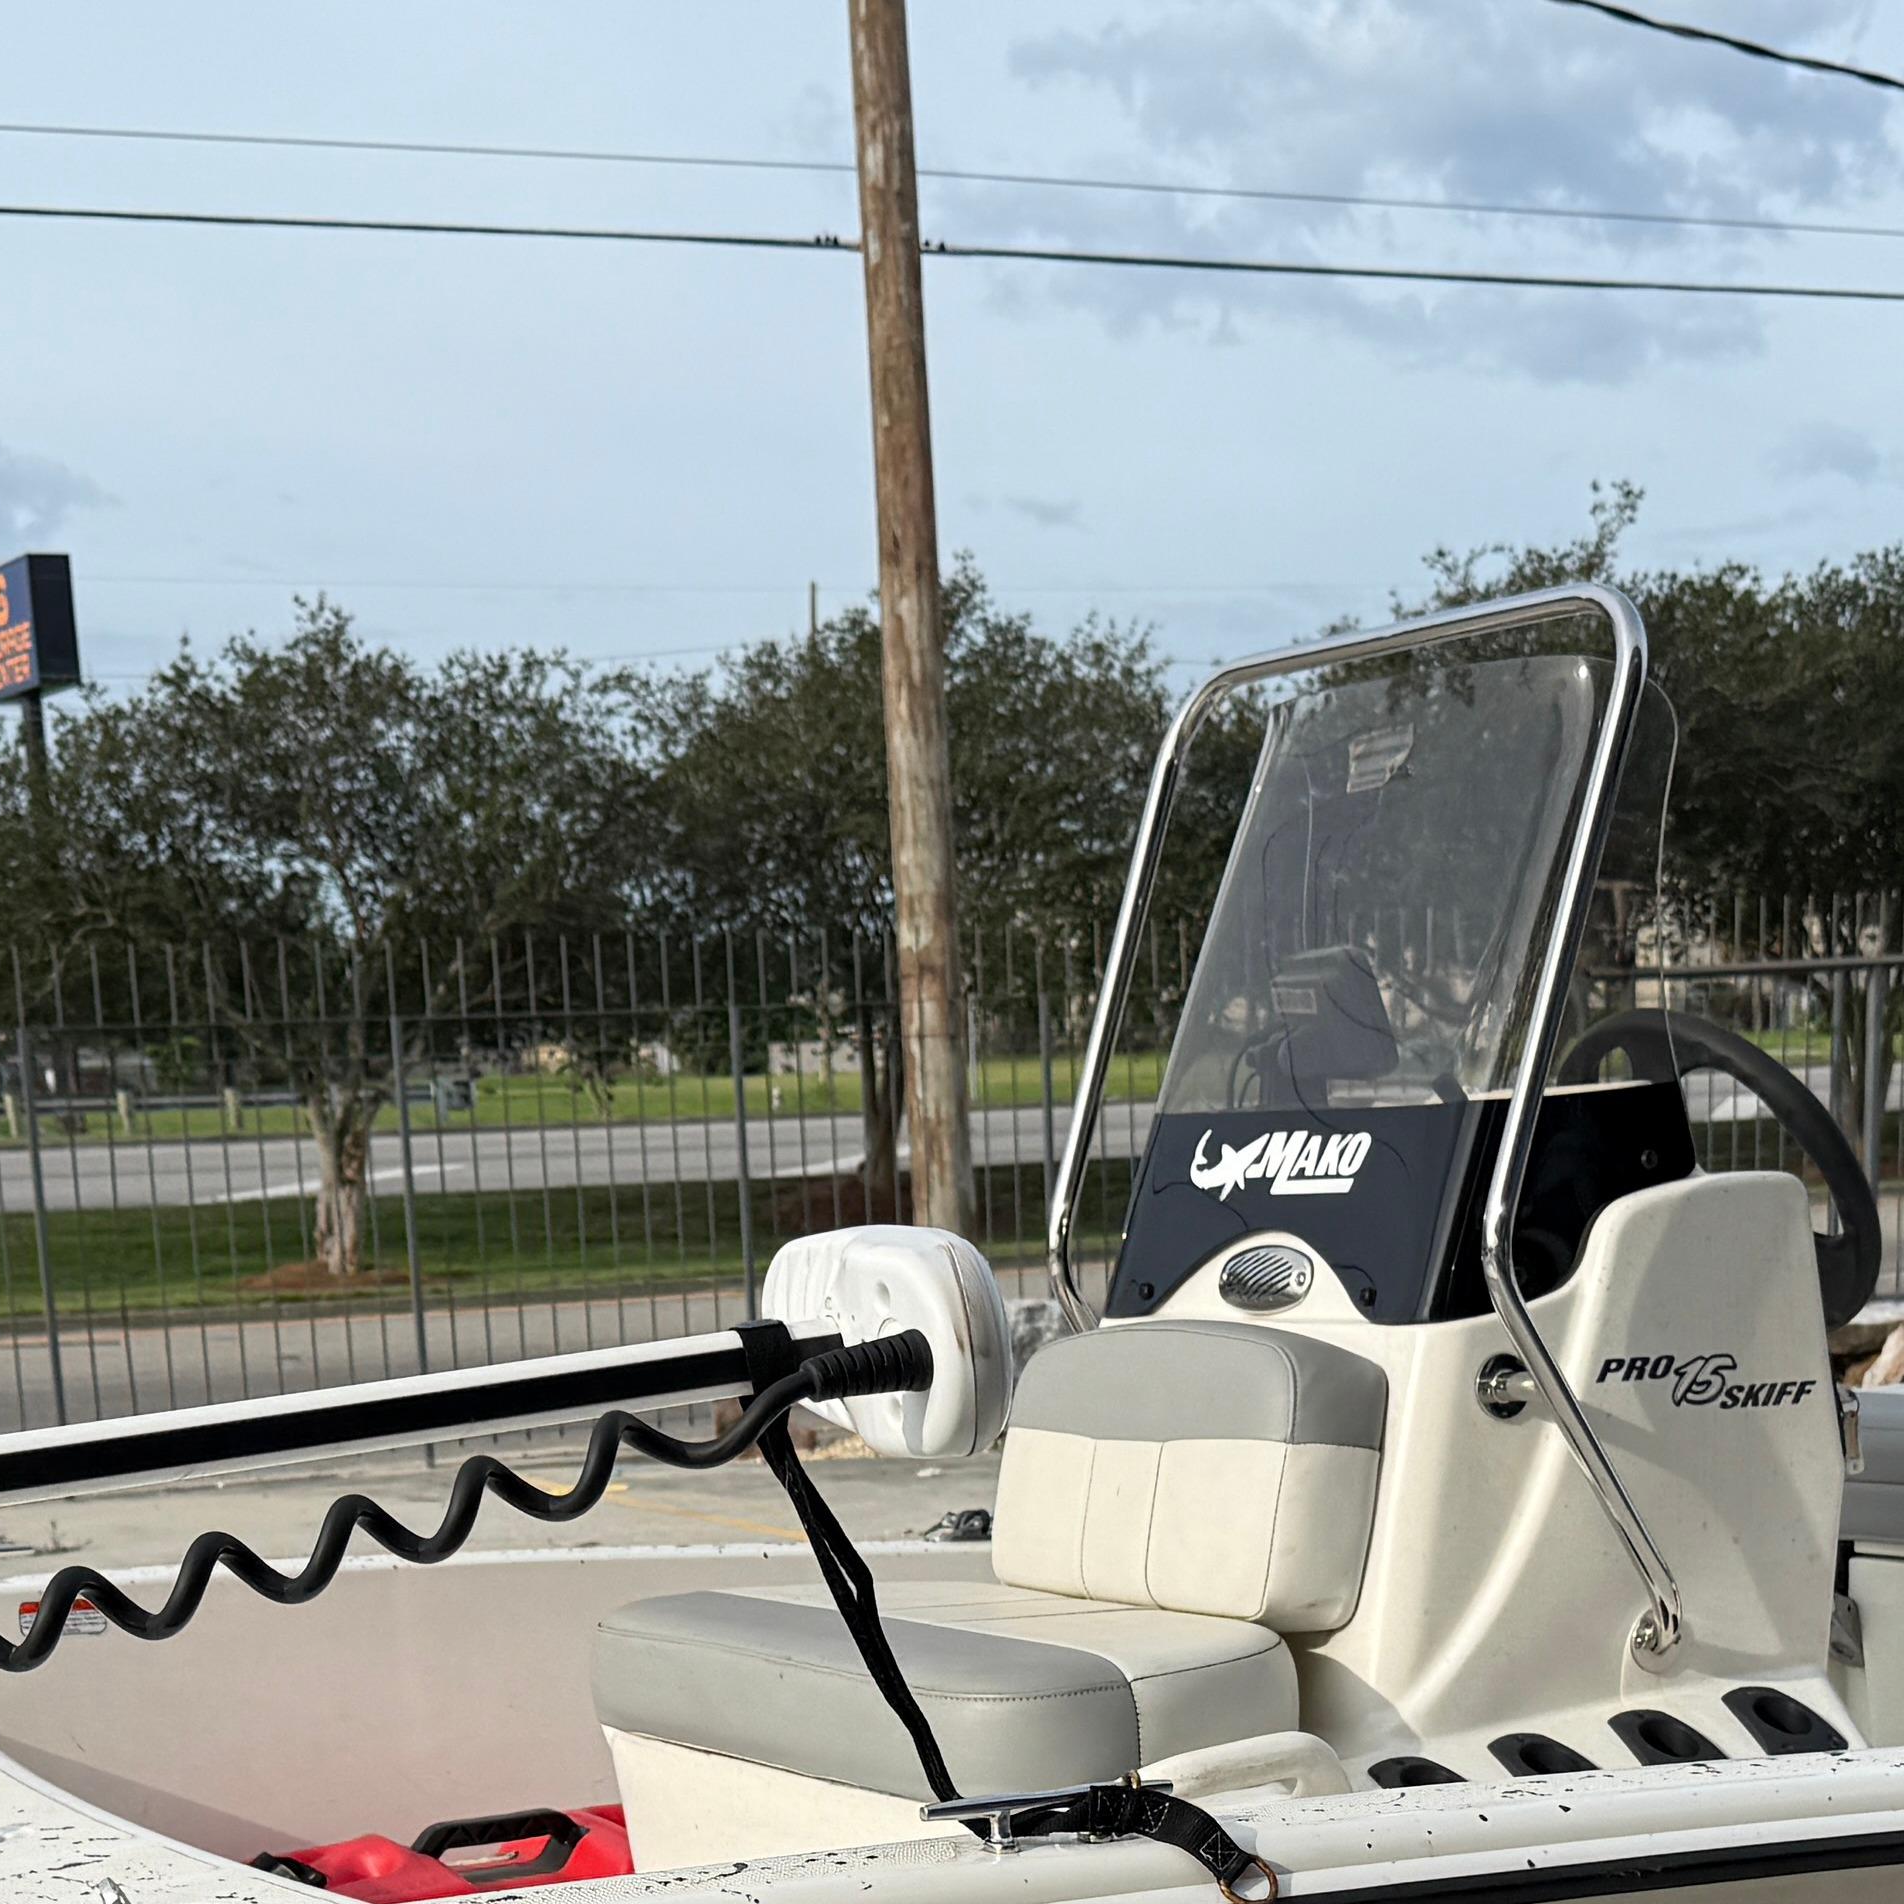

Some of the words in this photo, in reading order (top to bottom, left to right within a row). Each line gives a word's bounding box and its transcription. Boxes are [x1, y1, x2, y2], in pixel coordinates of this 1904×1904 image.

[1245, 1130, 1372, 1195] MAKO
[1596, 1354, 1675, 1383] PRO
[1672, 1354, 1737, 1407] 15
[1720, 1380, 1816, 1409] SKIFF
